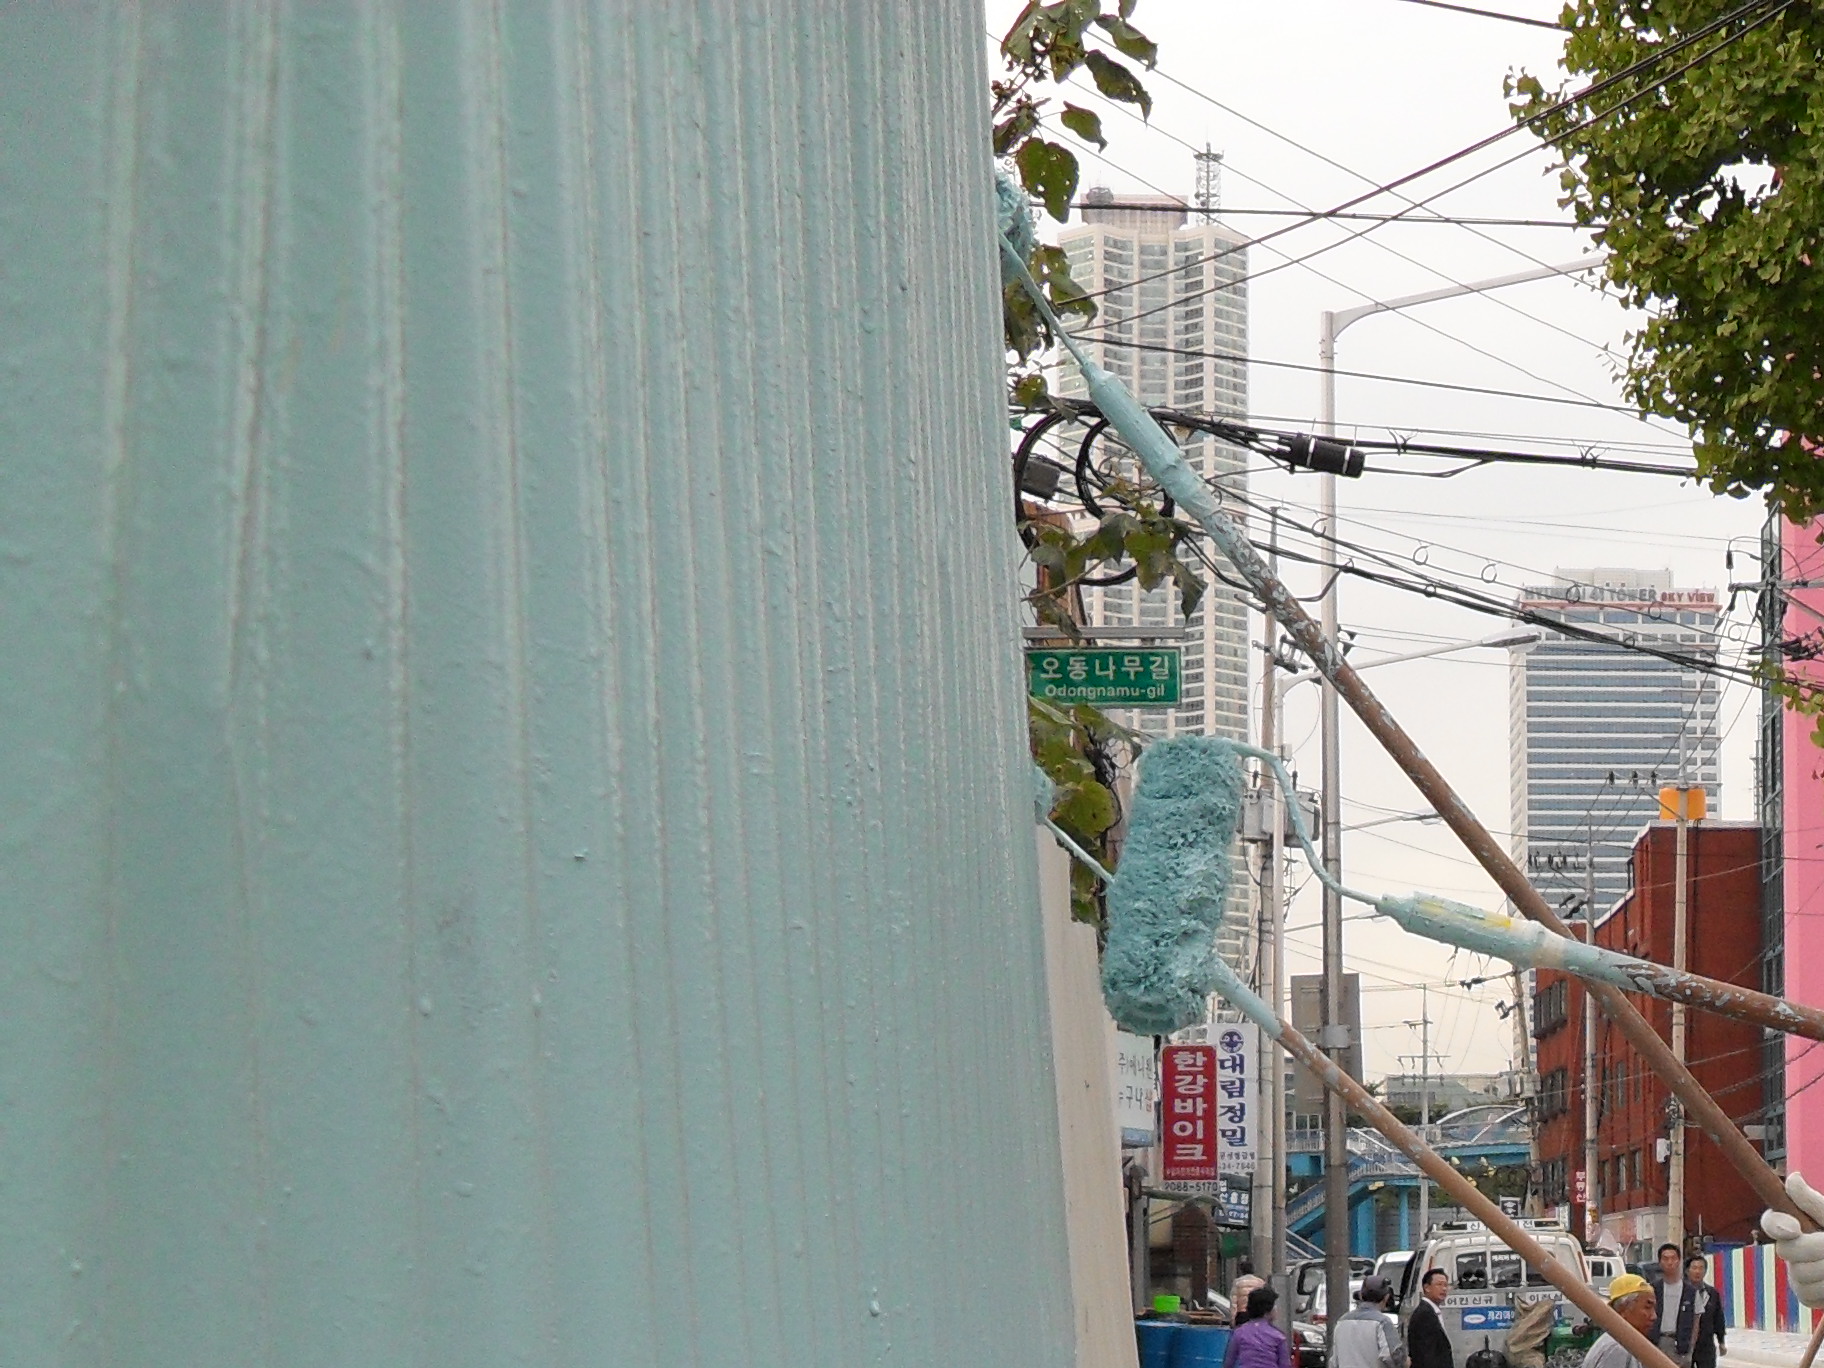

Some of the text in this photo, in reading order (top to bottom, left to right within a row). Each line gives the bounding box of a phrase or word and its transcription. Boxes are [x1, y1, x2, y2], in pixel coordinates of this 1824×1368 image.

[1608, 588, 1657, 602] TOWER
[1040, 655, 1170, 681] 오동나무길
[1044, 683, 1166, 699] Odongnamu-gil
[1172, 1051, 1209, 1161] 한강바이크
[1217, 1053, 1248, 1147] 대림정밀
